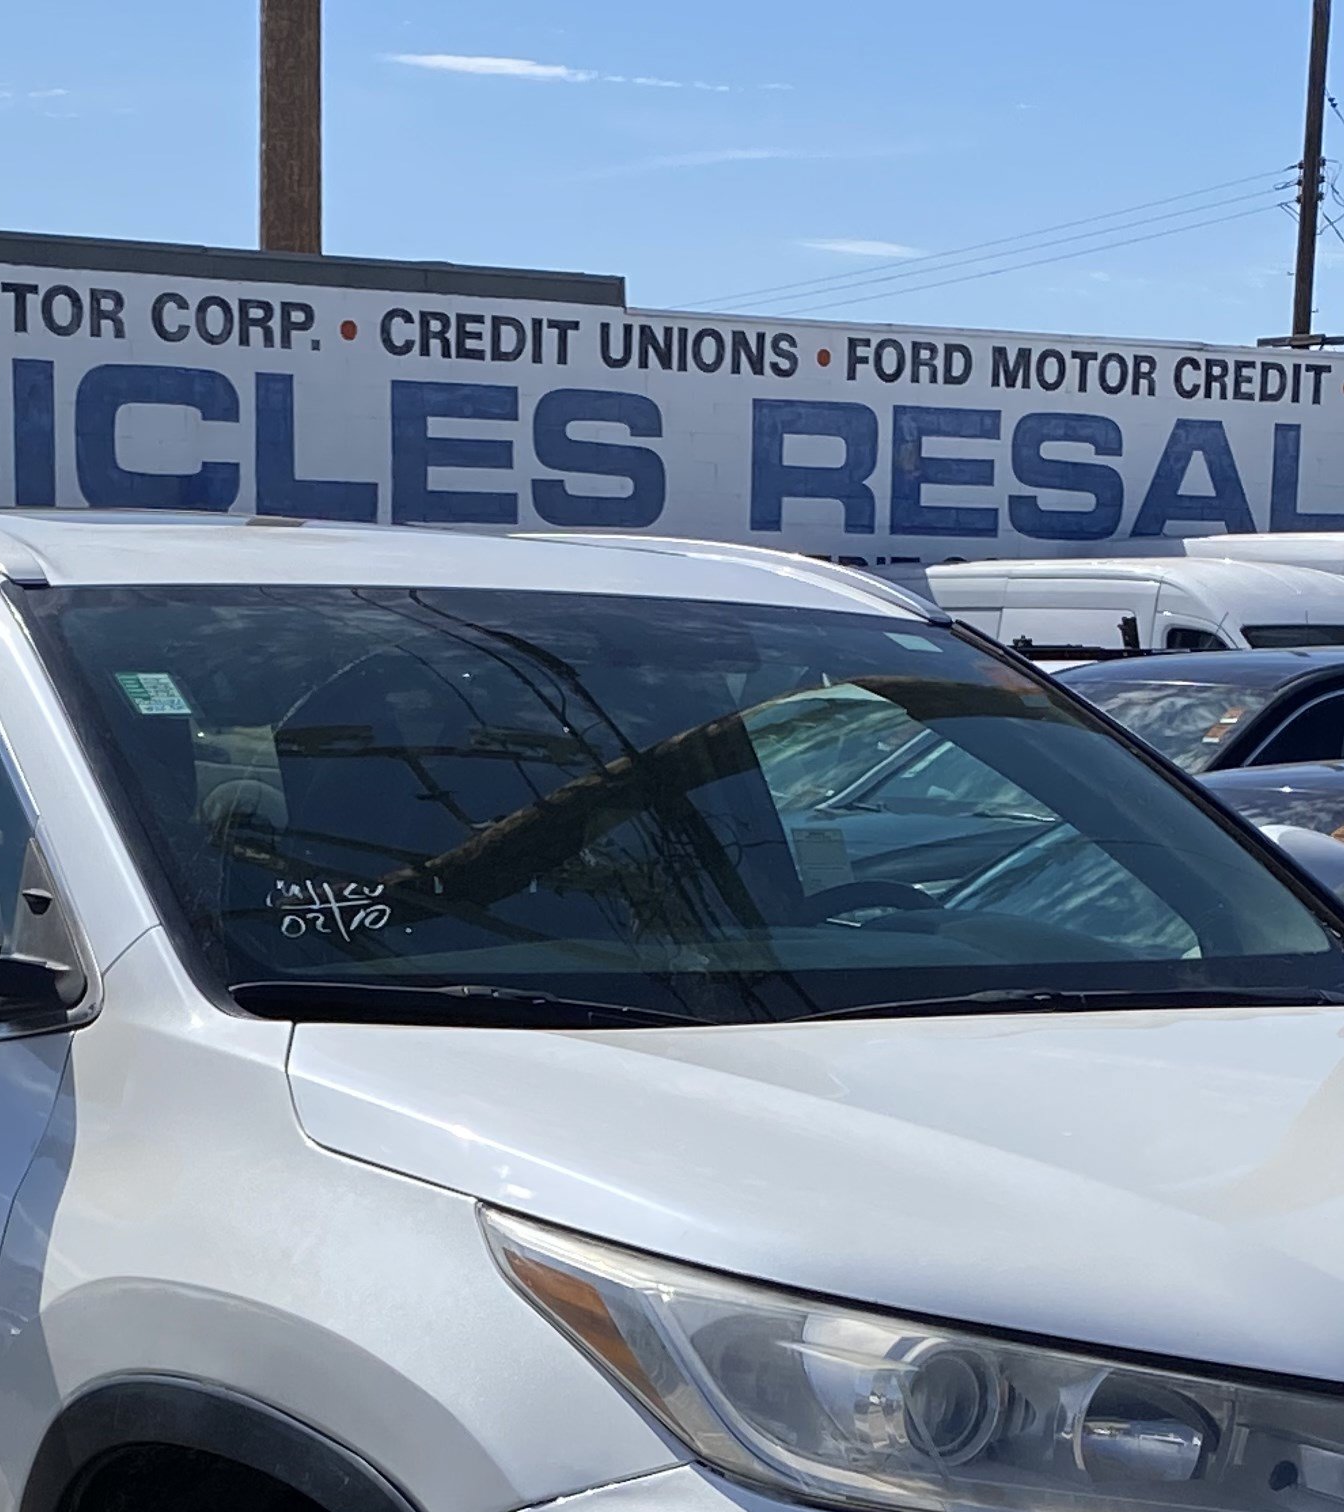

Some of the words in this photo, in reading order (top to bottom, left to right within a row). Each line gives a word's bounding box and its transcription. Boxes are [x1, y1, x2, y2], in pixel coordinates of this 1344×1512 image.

[150, 290, 322, 351] CORP.
[380, 308, 580, 365] CREDIT
[600, 322, 799, 378] UNIONS
[846, 336, 974, 385] FORD
[990, 345, 1157, 397] MOTOR
[1173, 354, 1333, 406] CREDIT
